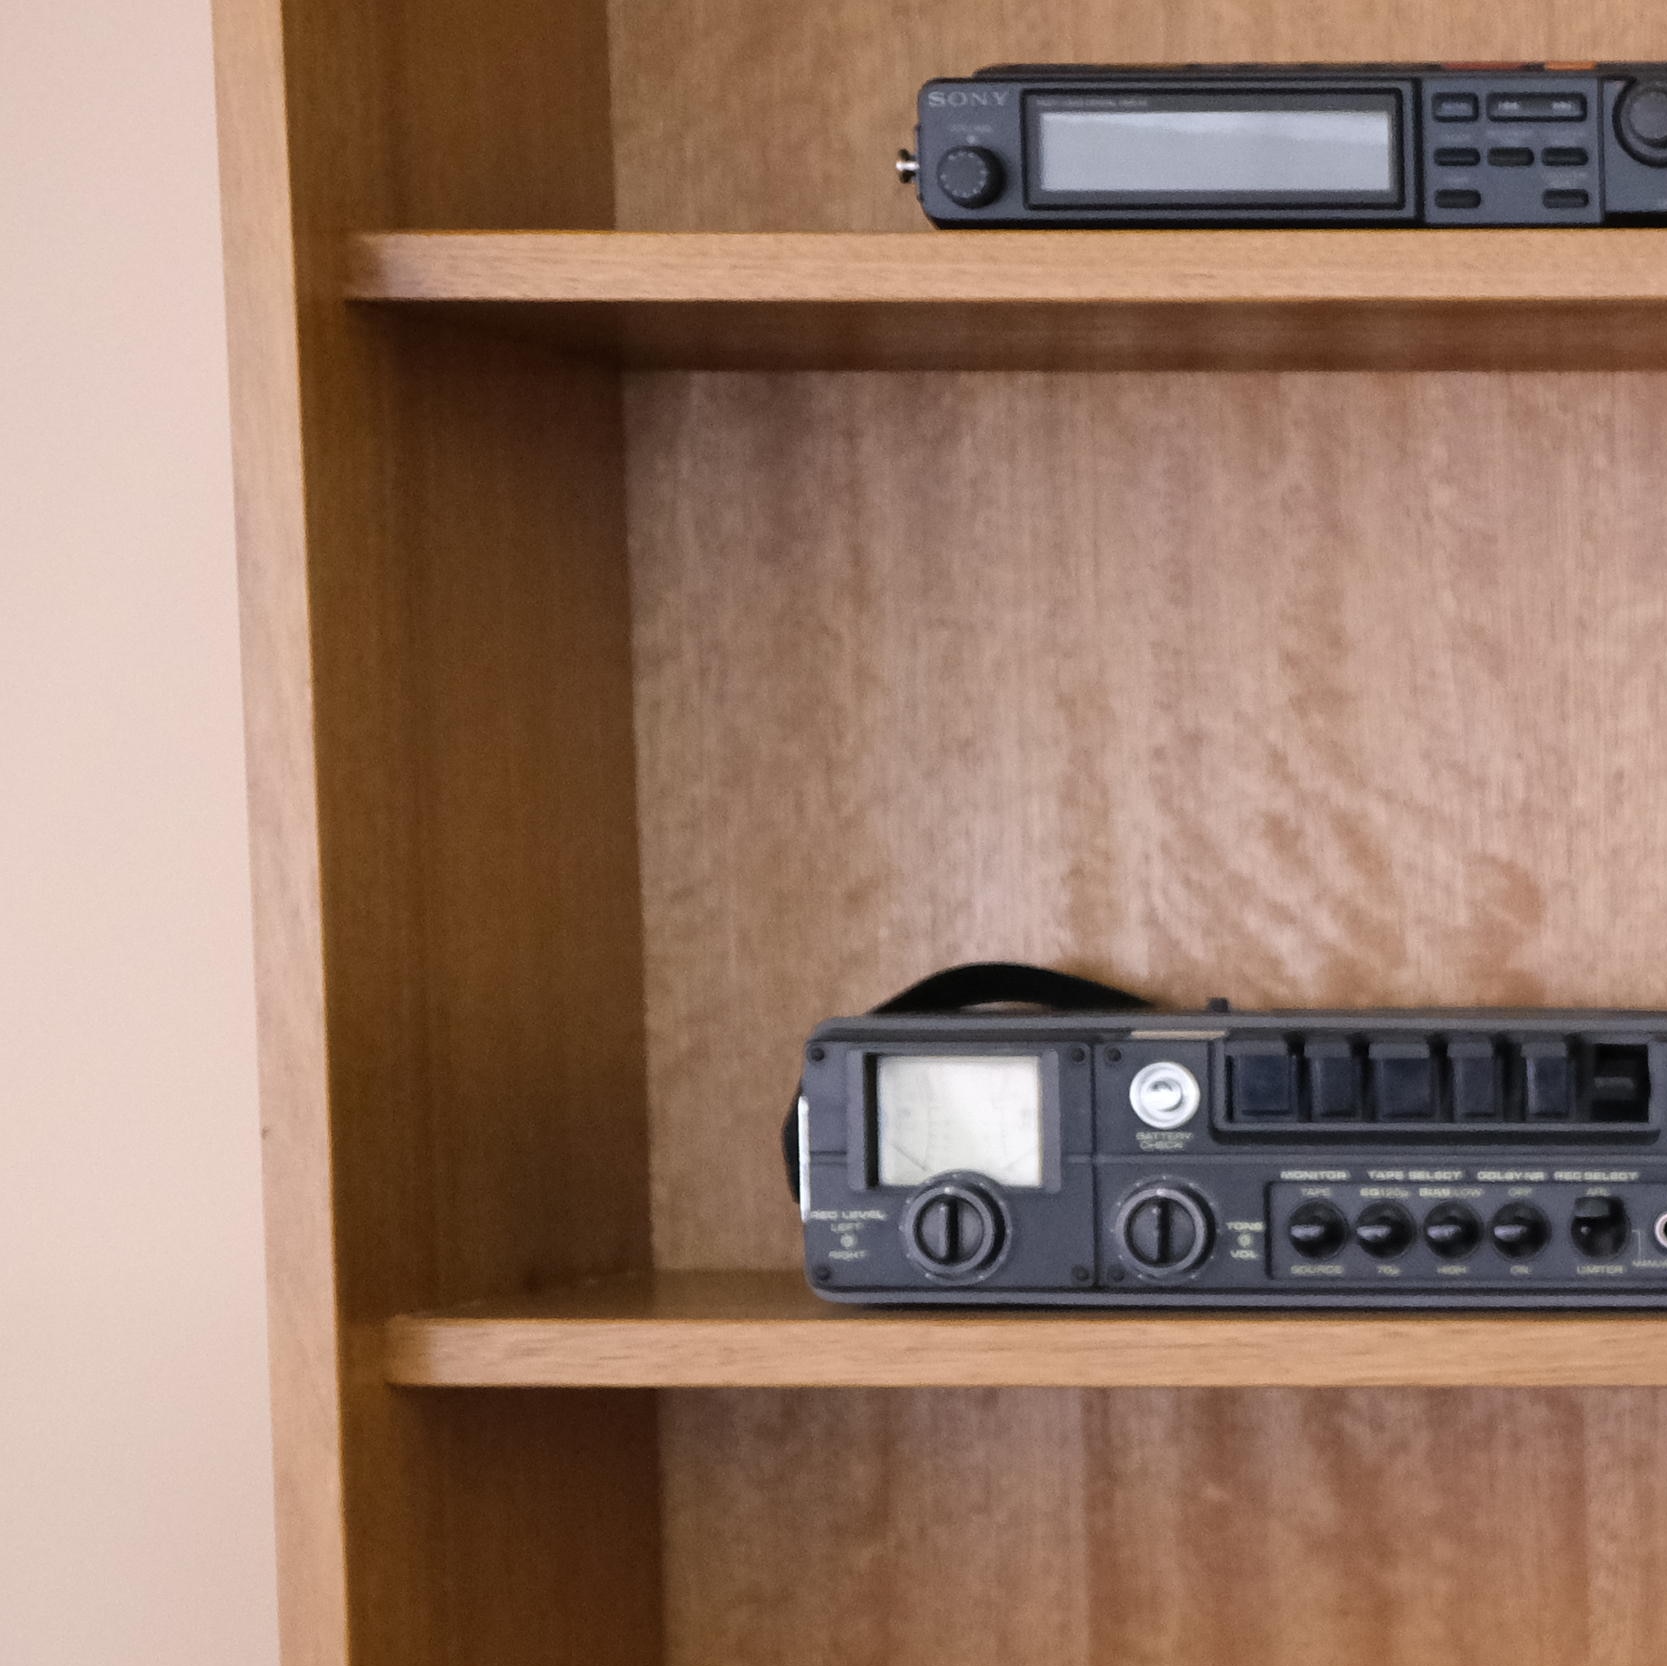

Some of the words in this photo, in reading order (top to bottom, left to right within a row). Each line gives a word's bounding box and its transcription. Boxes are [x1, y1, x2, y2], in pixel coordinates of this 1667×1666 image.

[927, 91, 1009, 107] SONY
[1135, 1132, 1194, 1141] BATTERY
[1139, 1140, 1185, 1150] CHECK
[1280, 1170, 1350, 1181] MONITOR
[1367, 1170, 1404, 1181] TAPE
[1408, 1170, 1464, 1181] SELECT
[1477, 1171, 1522, 1181] DOLBY
[1553, 1171, 1582, 1181] REC
[1584, 1171, 1639, 1181] SELECT
[1301, 1188, 1333, 1197] TAPE
[810, 1210, 836, 1221] REC
[840, 1210, 886, 1221] LEVEL
[830, 1223, 862, 1232] LEFT
[1226, 1221, 1265, 1232] TONE
[829, 1250, 871, 1260] RIGHT
[1290, 1264, 1344, 1275] SOURCE
[1437, 1264, 1468, 1274] HIGH
[1576, 1264, 1626, 1275] LIMITER
